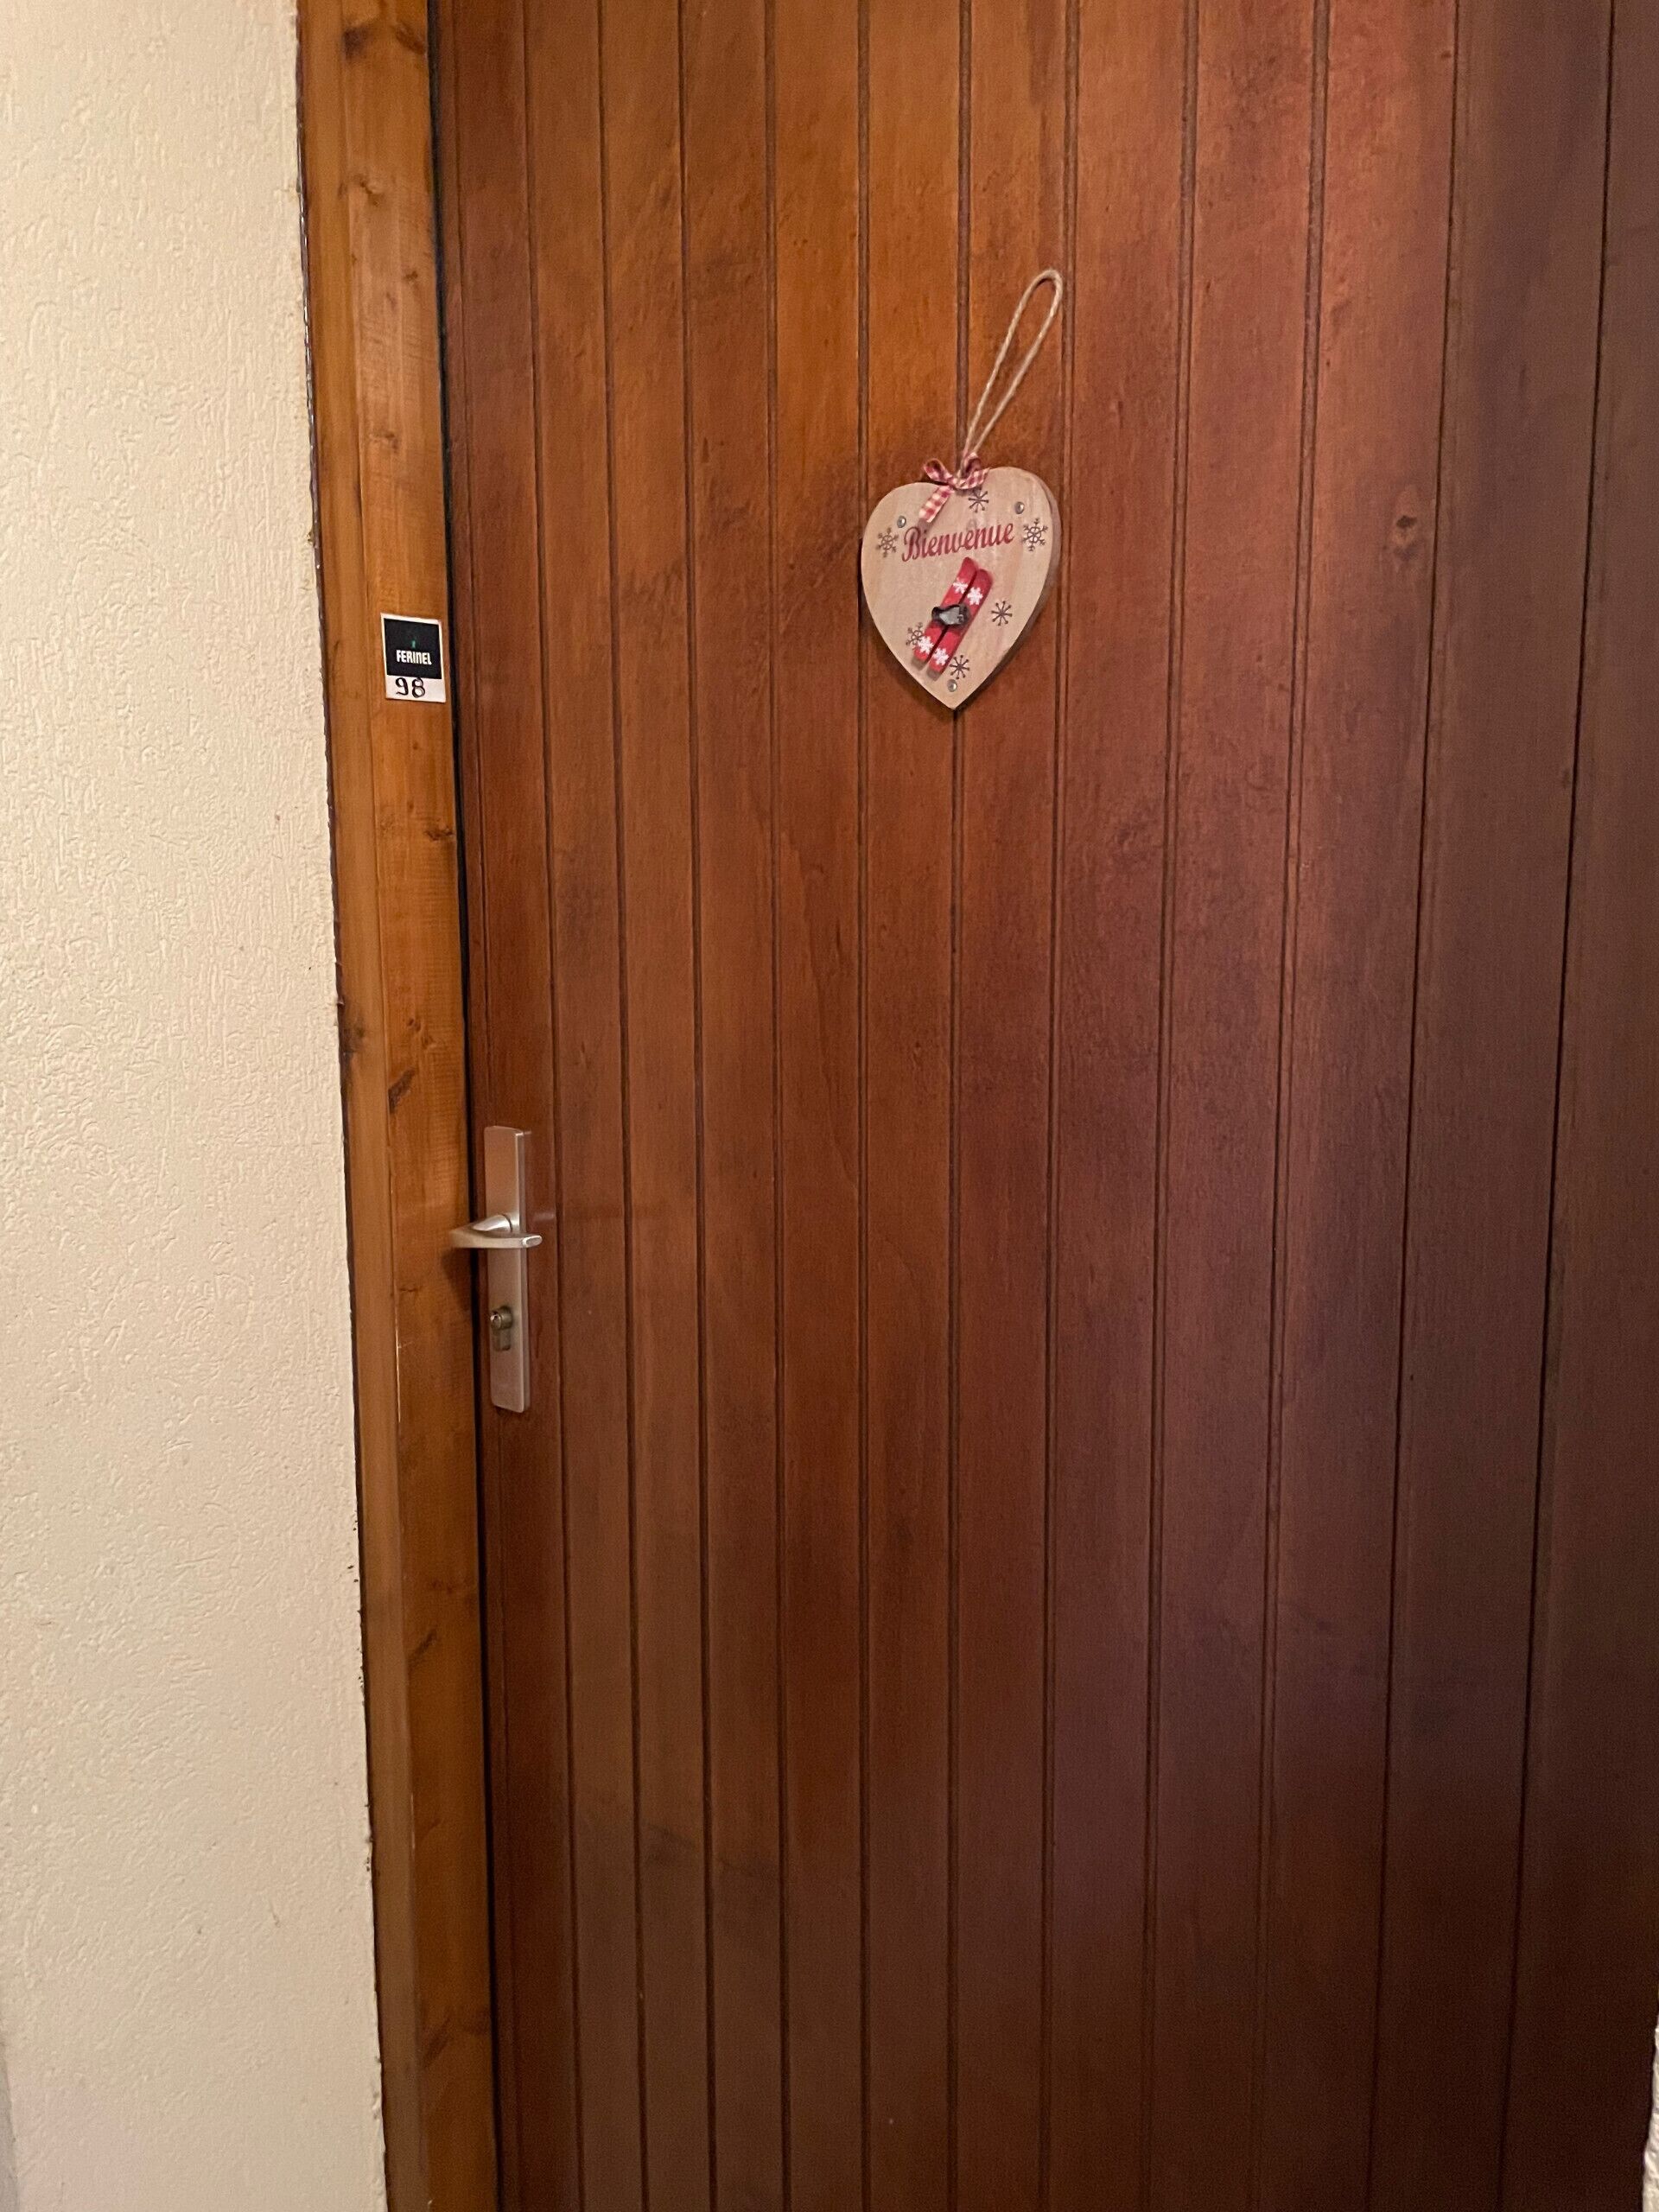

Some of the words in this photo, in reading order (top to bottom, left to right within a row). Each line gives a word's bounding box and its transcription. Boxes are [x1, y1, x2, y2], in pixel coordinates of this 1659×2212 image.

[901, 523, 1014, 562] Bienvenue
[396, 650, 432, 665] FERINEL
[395, 677, 426, 698] 98
